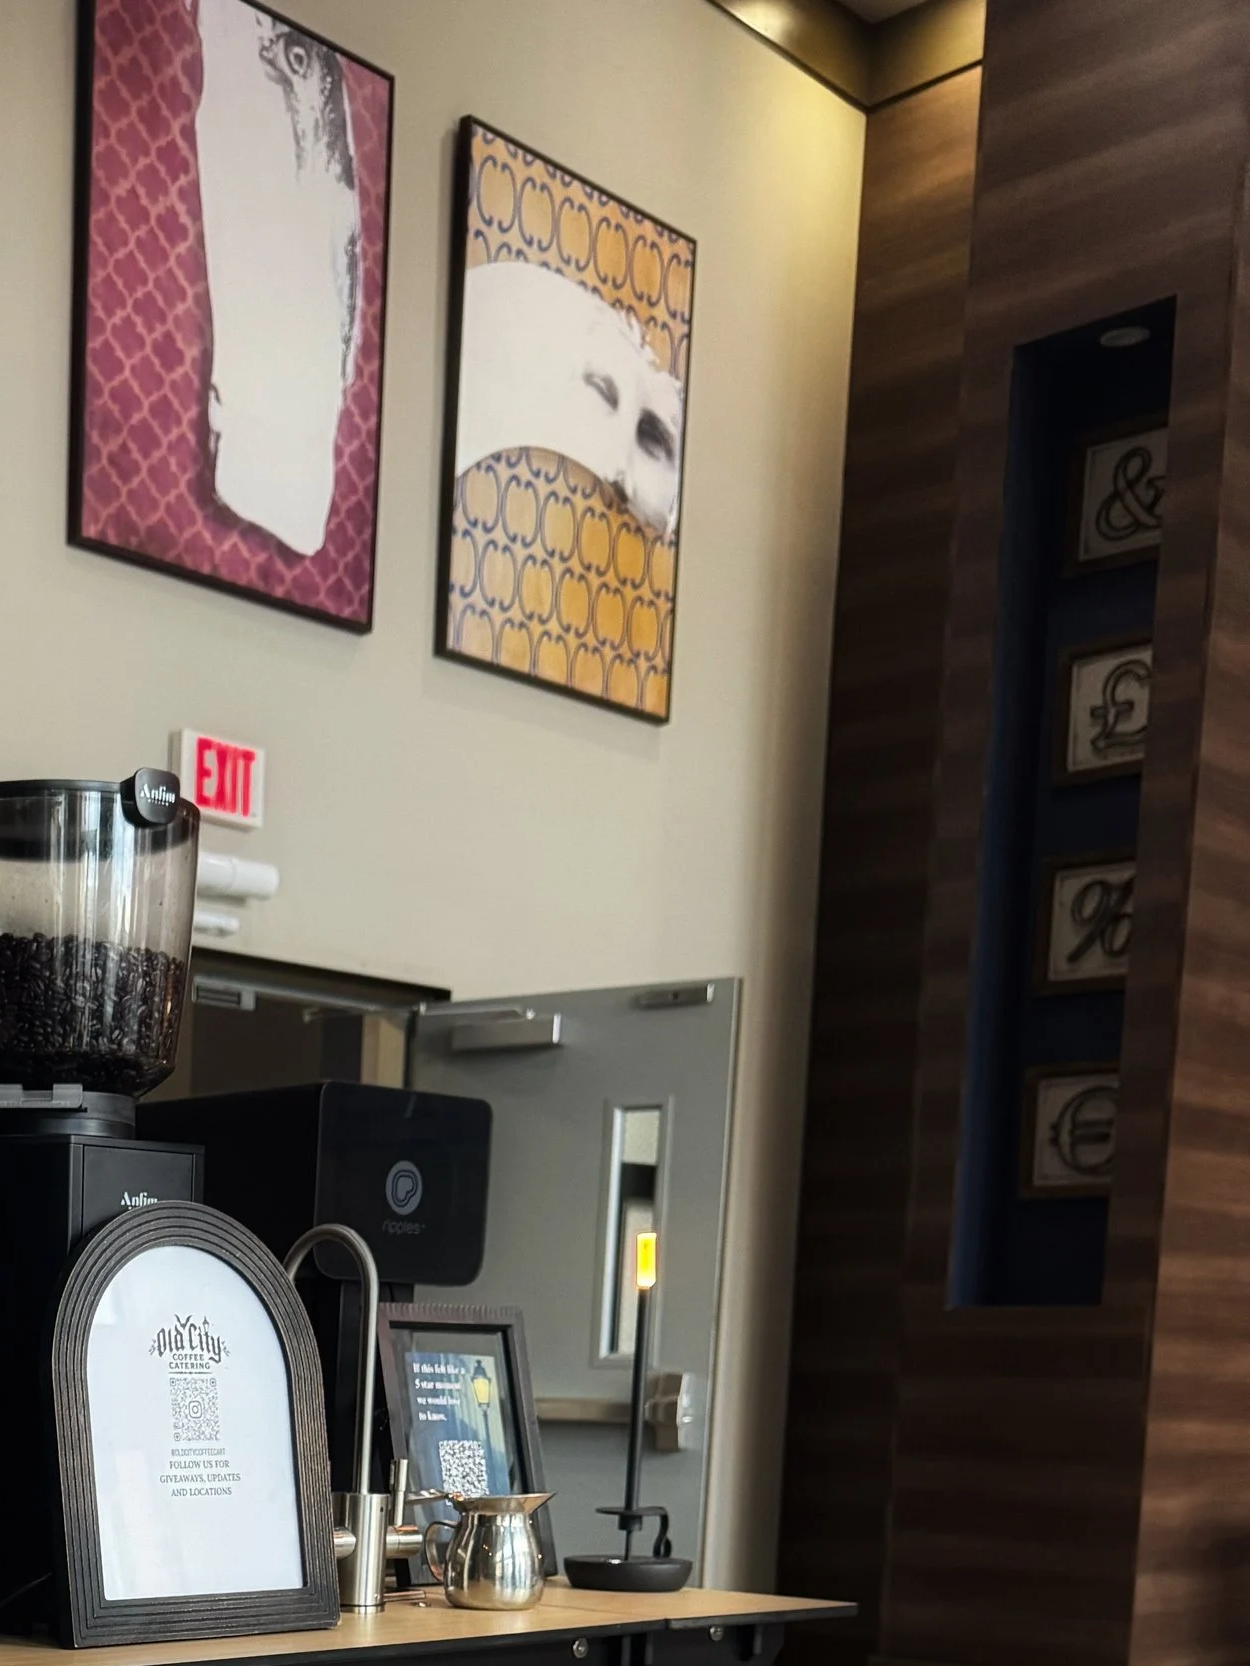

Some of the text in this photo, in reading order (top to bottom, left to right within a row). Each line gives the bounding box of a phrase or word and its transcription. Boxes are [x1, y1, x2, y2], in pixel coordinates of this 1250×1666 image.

[196, 737, 256, 817] EXIT
[140, 783, 175, 803] Anfim
[157, 1316, 221, 1363] Old City
[173, 1353, 204, 1361] COFFEE
[169, 1362, 210, 1370] CATERING
[421, 1364, 434, 1373] this
[417, 1397, 426, 1405] we
[427, 1395, 447, 1405] would
[419, 1412, 427, 1421] to
[169, 1460, 230, 1469] FOLLOW US FOR
[159, 1473, 241, 1484] GIVEAWAYS, UPDATES
[171, 1487, 232, 1497] AND LOCATIONS
